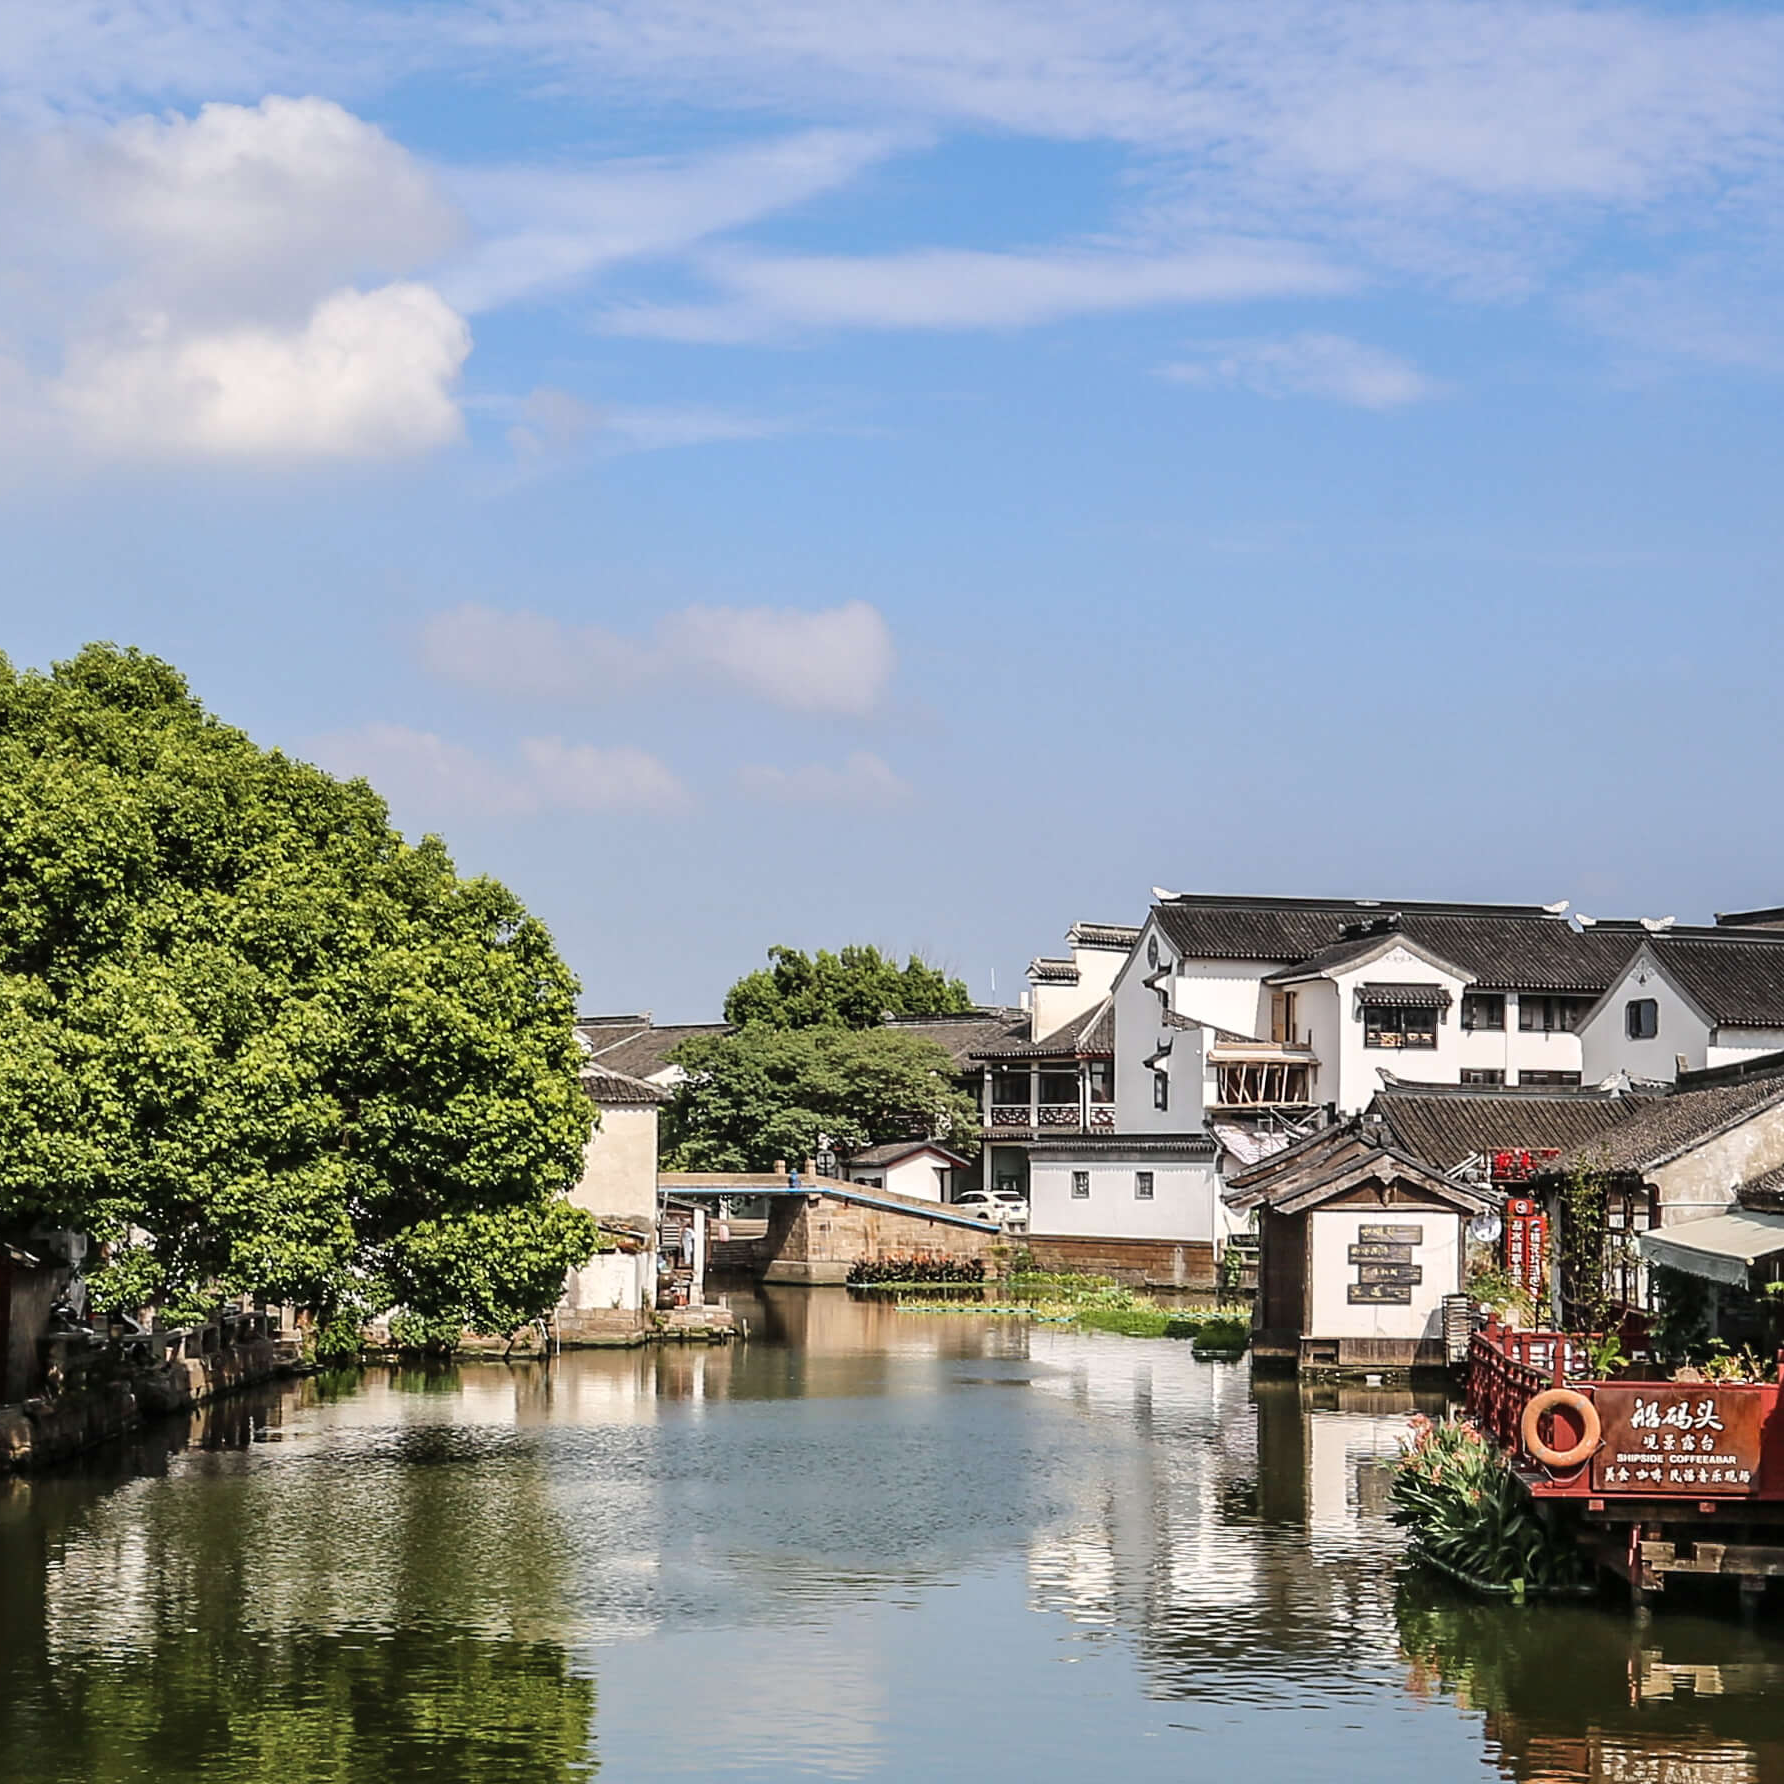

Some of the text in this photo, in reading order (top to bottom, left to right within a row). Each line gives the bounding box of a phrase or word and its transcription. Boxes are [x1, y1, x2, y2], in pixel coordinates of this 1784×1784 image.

[1630, 1398, 1724, 1430] 船码头
[1643, 1434, 1714, 1451] 观景露台
[1617, 1453, 1664, 1463] SHIPSIDE
